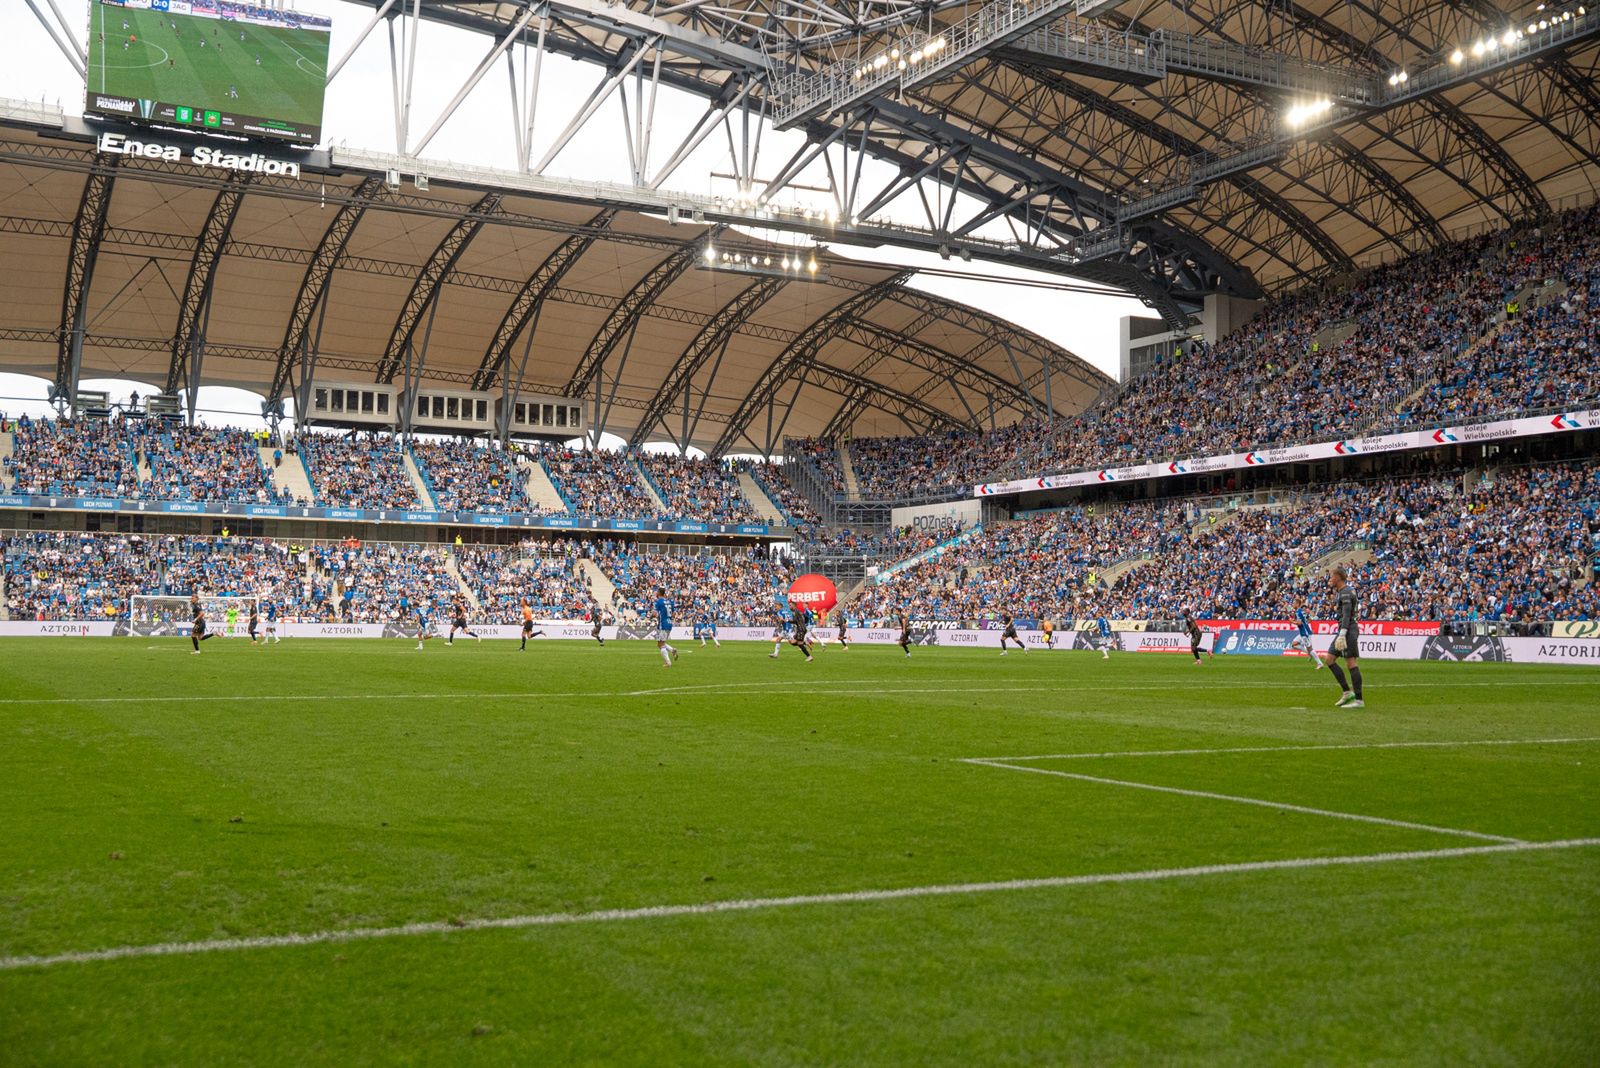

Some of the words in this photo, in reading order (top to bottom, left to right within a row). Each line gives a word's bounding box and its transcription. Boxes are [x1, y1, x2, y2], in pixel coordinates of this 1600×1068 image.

[100, 133, 181, 161] Enea
[191, 146, 298, 177] Stadion
[1464, 424, 1488, 433] Koleje
[1464, 428, 1517, 441] Wielkopolskie
[1362, 436, 1382, 445] Koleje
[1362, 440, 1408, 452] Wielkopolskie
[1269, 448, 1287, 456] Koleje
[1269, 453, 1309, 463] Wielkopolskie
[41, 625, 90, 633] AZTORIN
[562, 629, 591, 637] AZTOR
[868, 632, 891, 641] AZTORIN
[951, 634, 978, 643] AZTORIN
[1140, 637, 1179, 648] AZTORIN
[1360, 640, 1397, 653] TORIN
